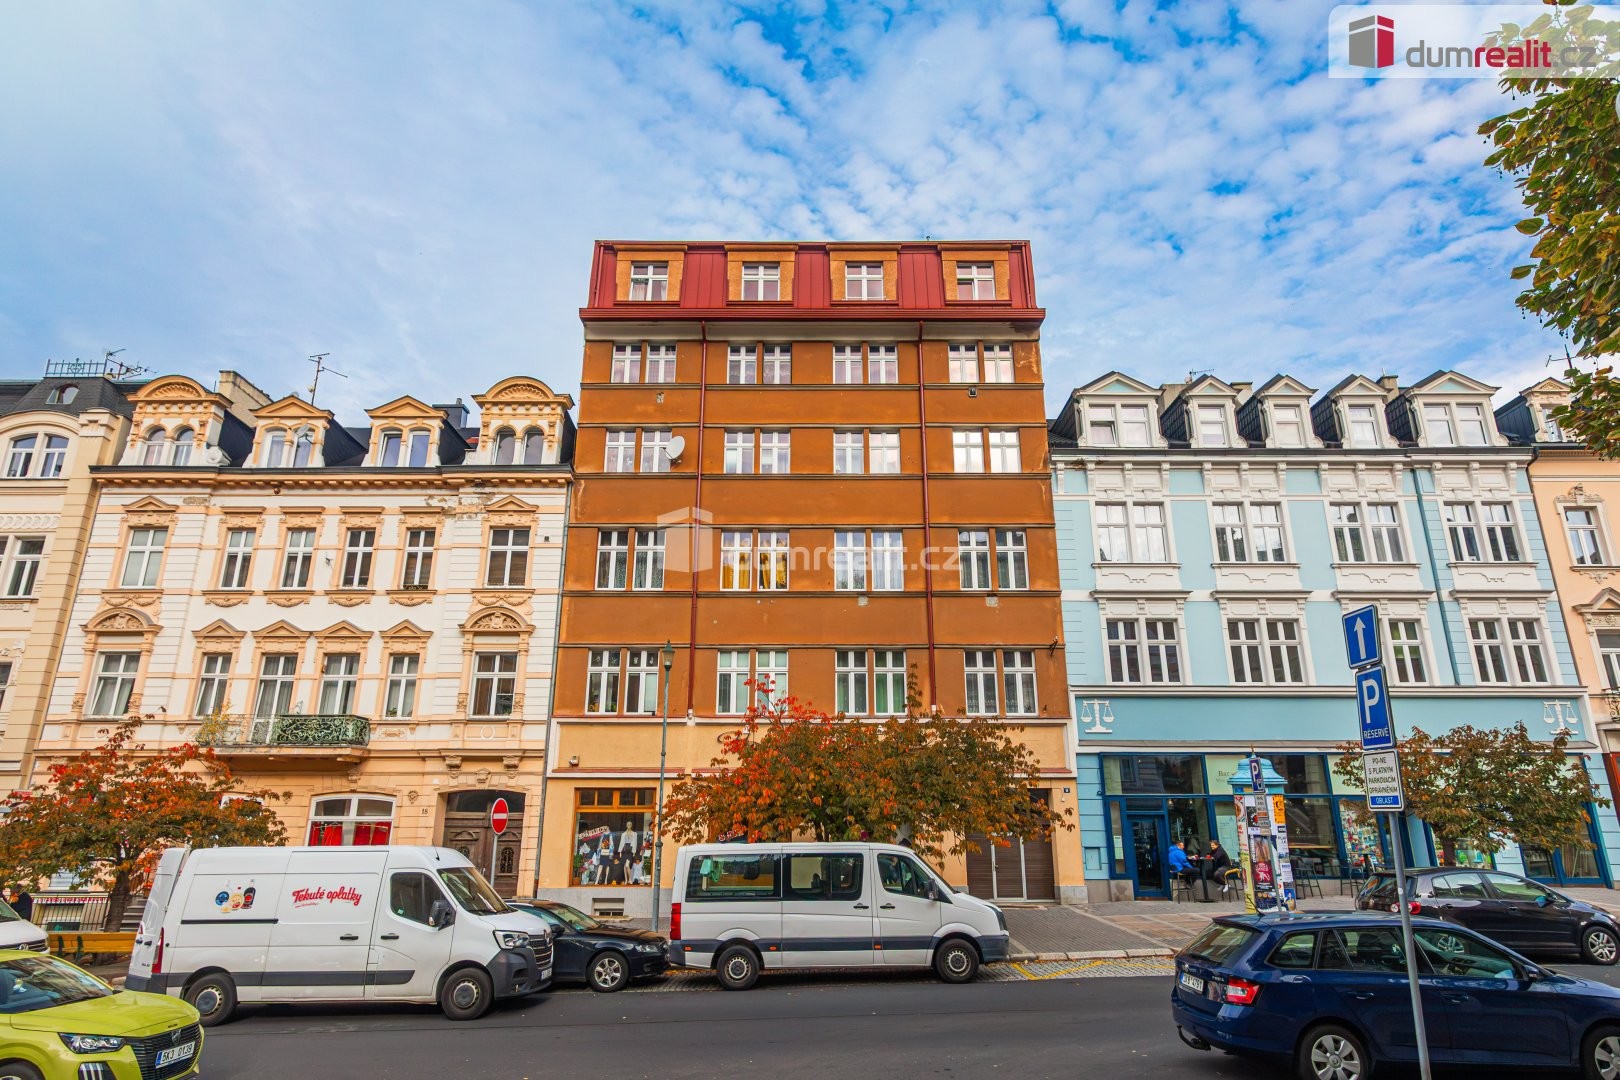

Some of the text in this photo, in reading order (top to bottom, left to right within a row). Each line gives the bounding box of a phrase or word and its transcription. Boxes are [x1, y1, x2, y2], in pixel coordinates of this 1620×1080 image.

[1362, 679, 1380, 724] P
[1363, 725, 1390, 739] RÉSERVÉ
[1251, 762, 1259, 782] P
[292, 885, 363, 907] Tekuté oplatky
